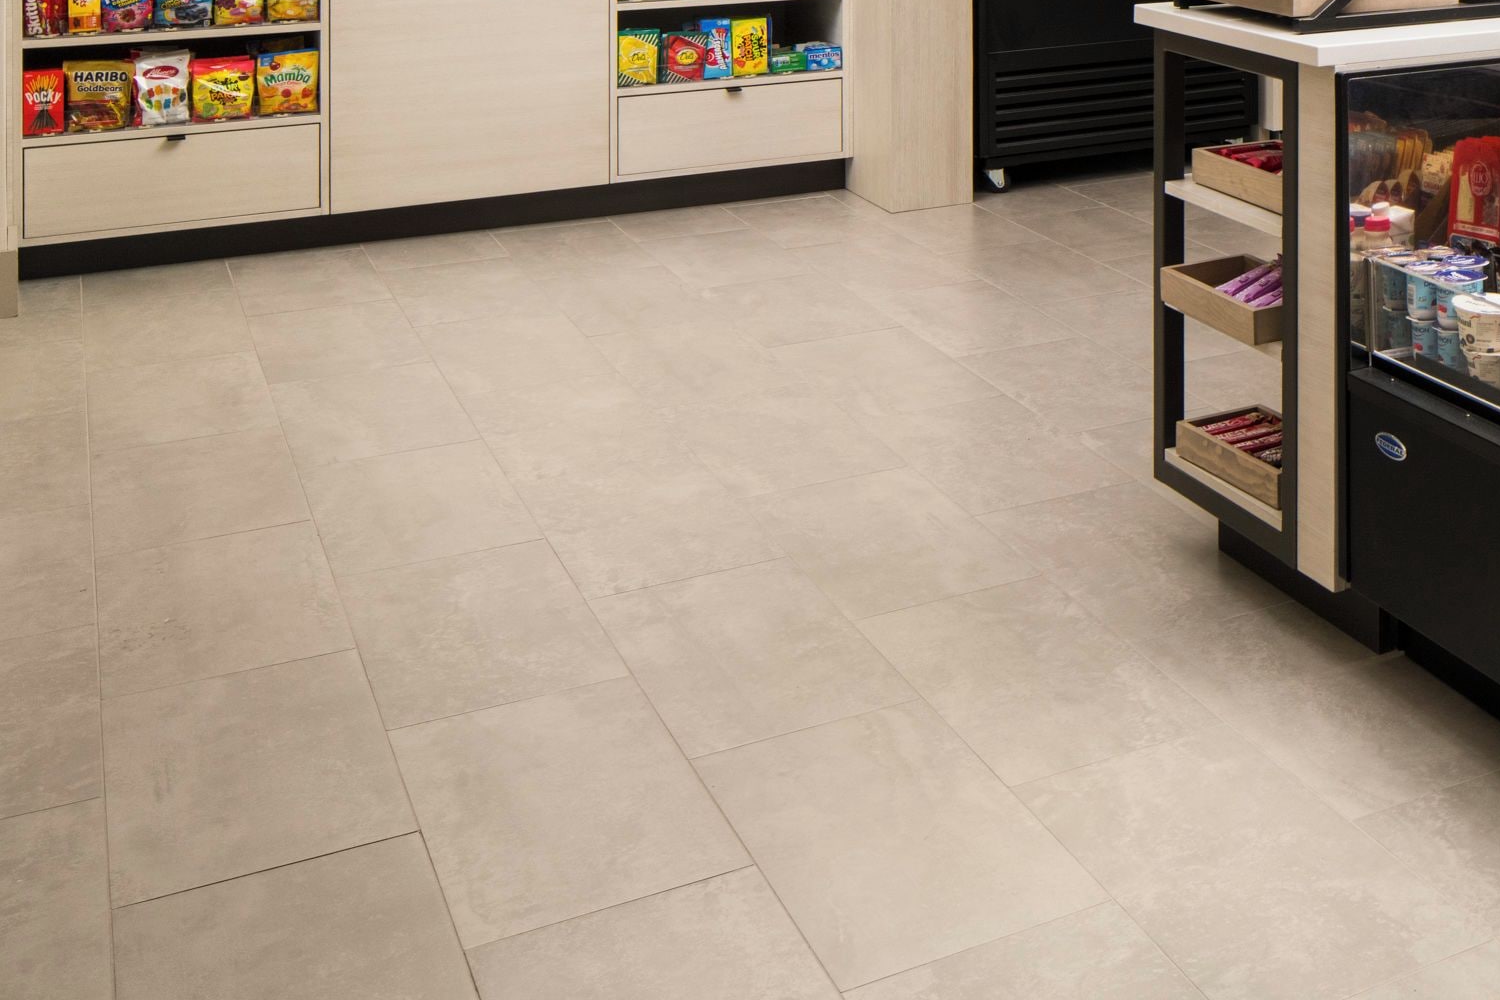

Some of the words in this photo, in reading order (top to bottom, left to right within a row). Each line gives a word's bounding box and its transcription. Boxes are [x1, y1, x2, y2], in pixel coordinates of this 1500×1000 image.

[809, 51, 840, 60] mentos
[74, 71, 129, 83] HARIBO
[264, 71, 311, 87] Mamba
